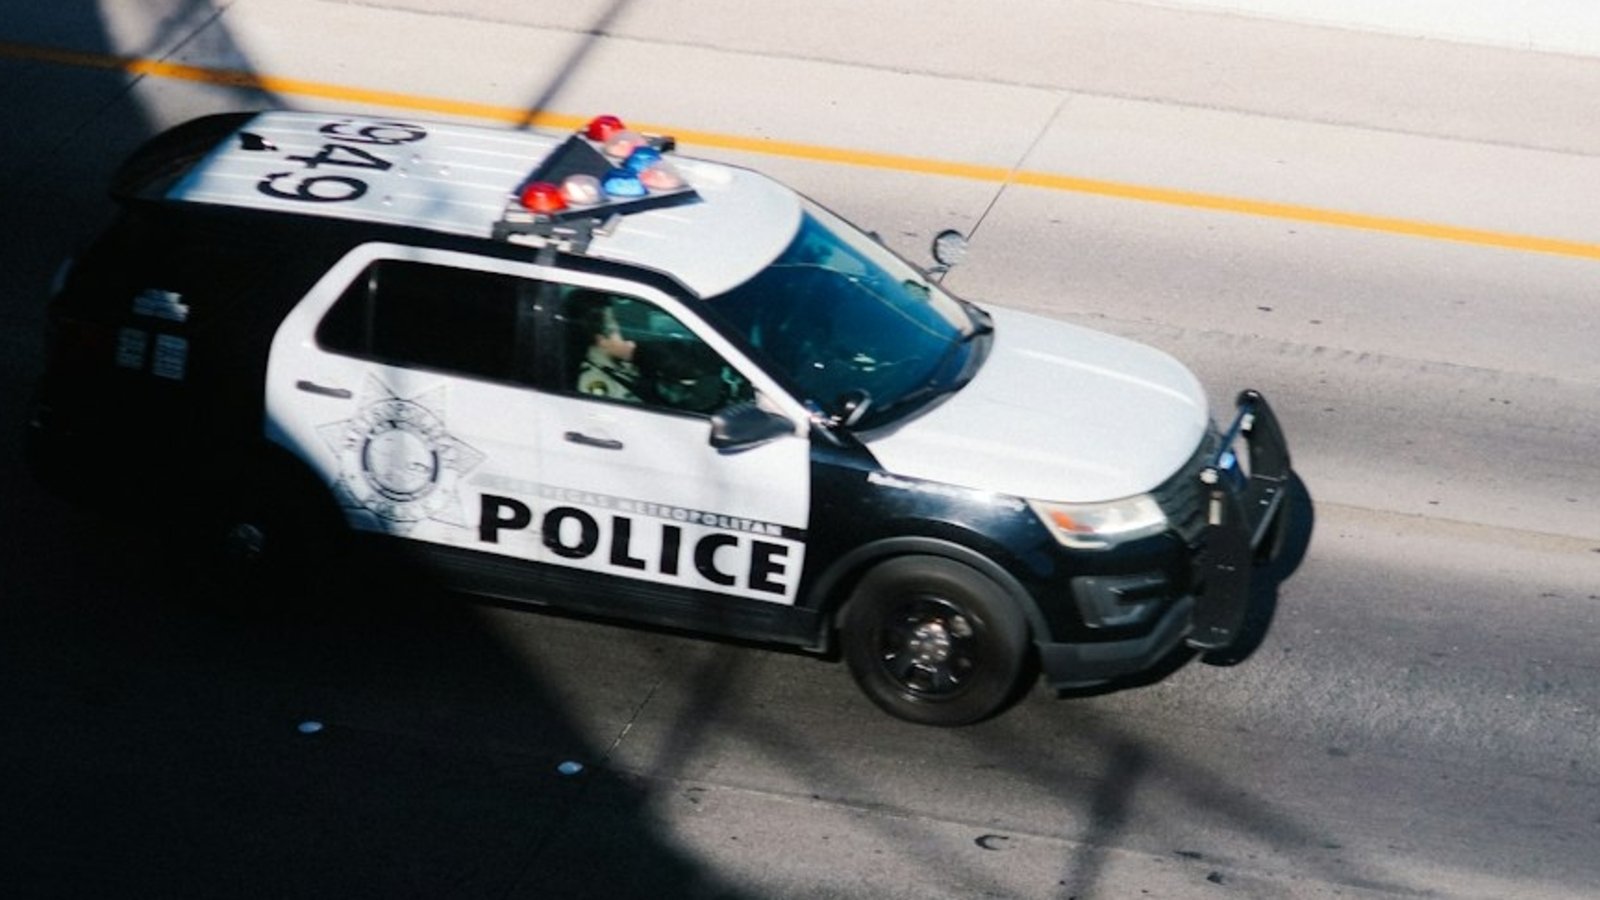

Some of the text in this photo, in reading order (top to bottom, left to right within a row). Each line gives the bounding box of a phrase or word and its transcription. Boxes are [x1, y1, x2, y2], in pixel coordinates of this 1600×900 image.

[257, 120, 427, 202] 949
[479, 493, 789, 595] POLICE
[617, 499, 783, 536] METROPOLITAN
